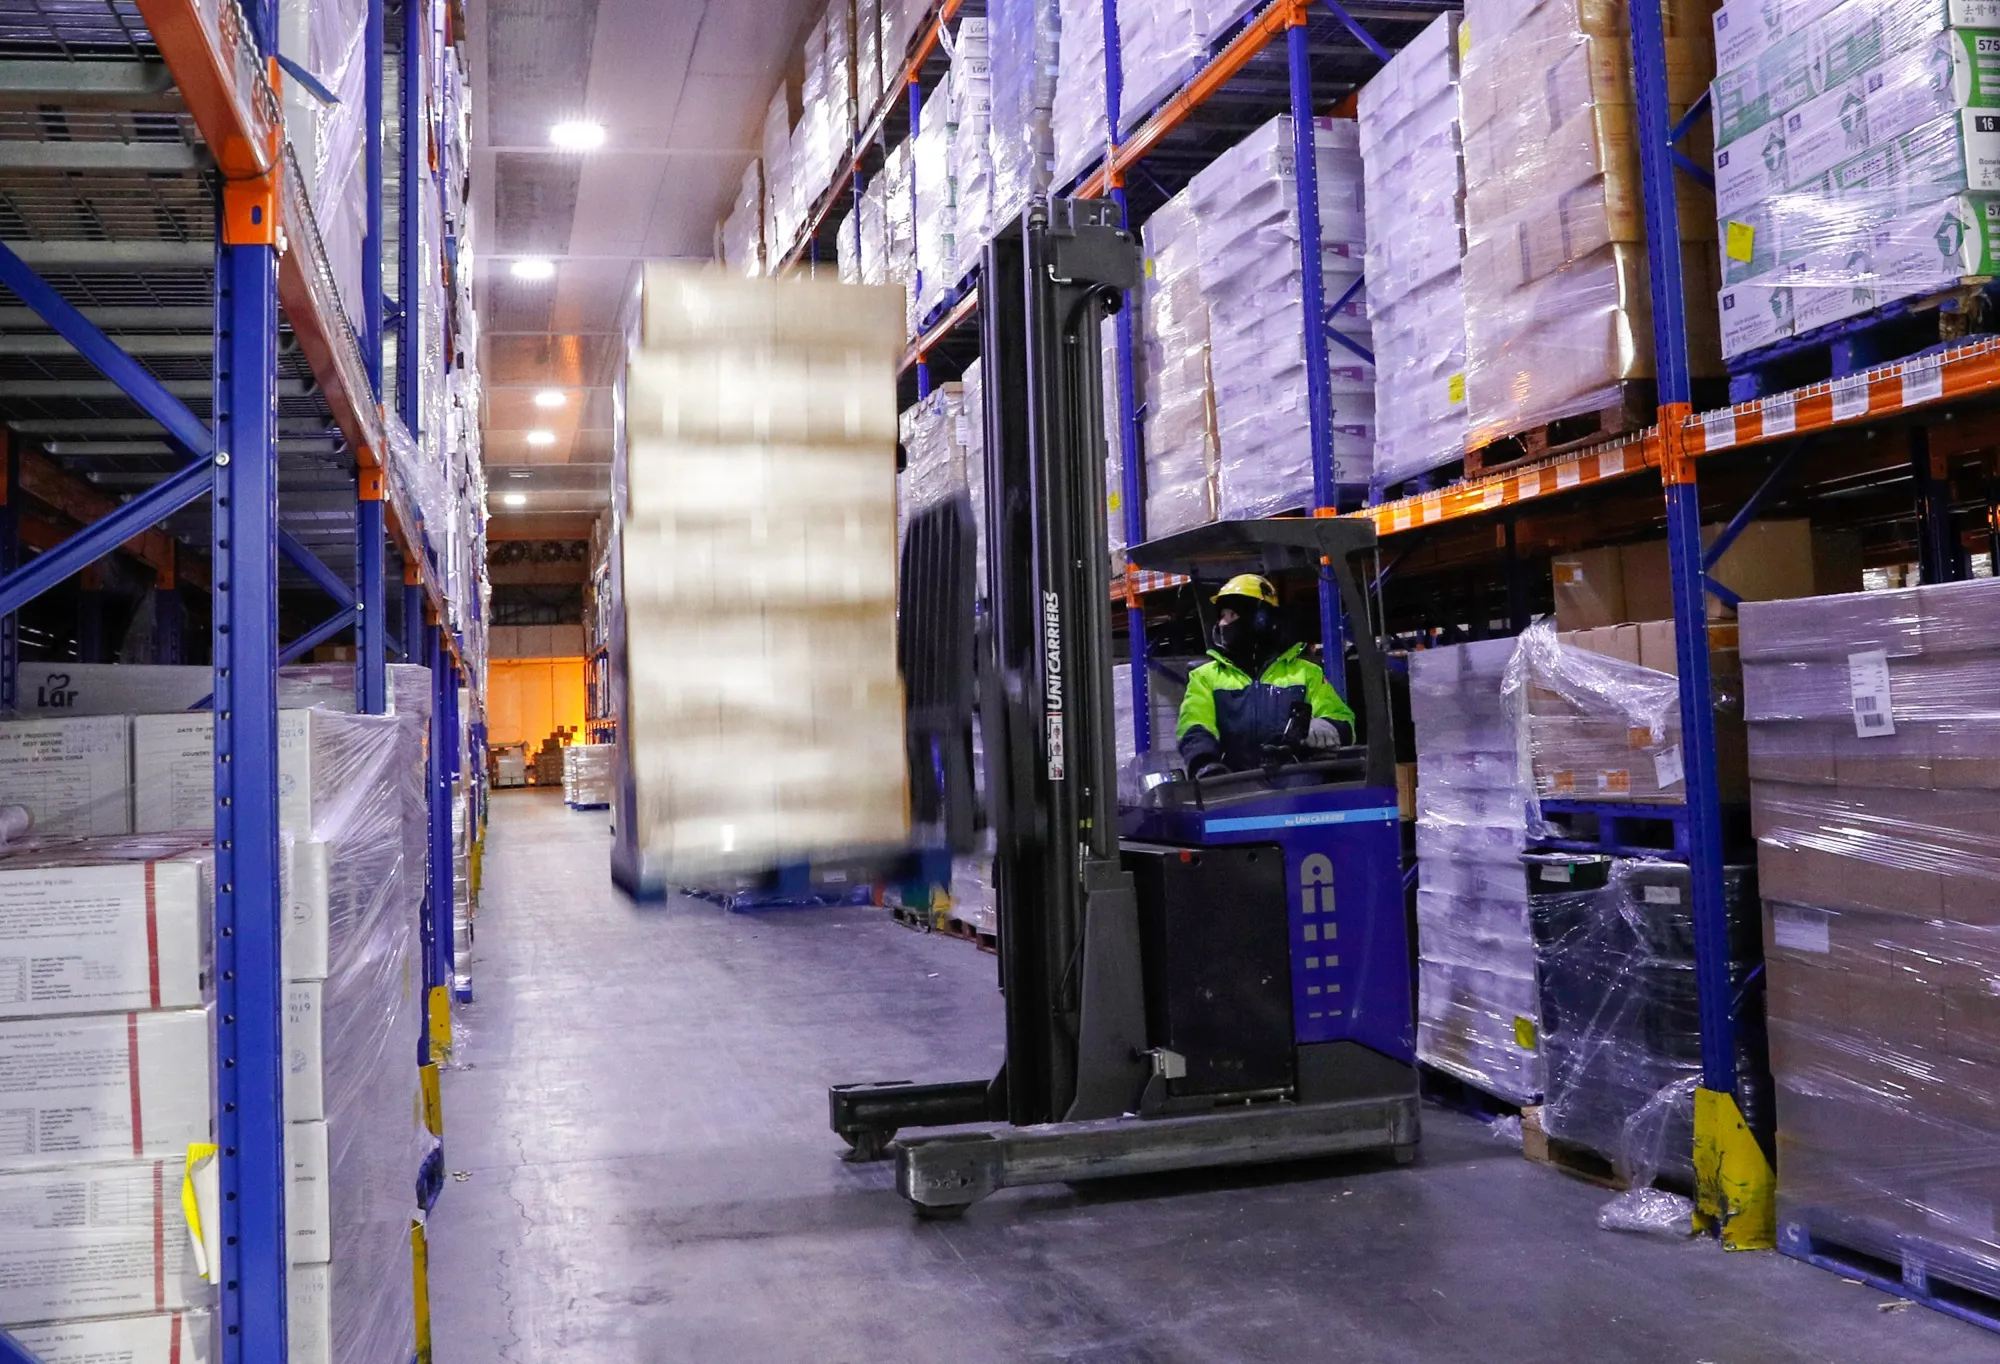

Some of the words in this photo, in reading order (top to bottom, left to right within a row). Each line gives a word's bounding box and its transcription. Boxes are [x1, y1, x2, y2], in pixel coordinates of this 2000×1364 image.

[1981, 117, 1994, 131] 16
[1046, 591, 1063, 710] UNICARRIERS
[37, 686, 79, 708] Lar
